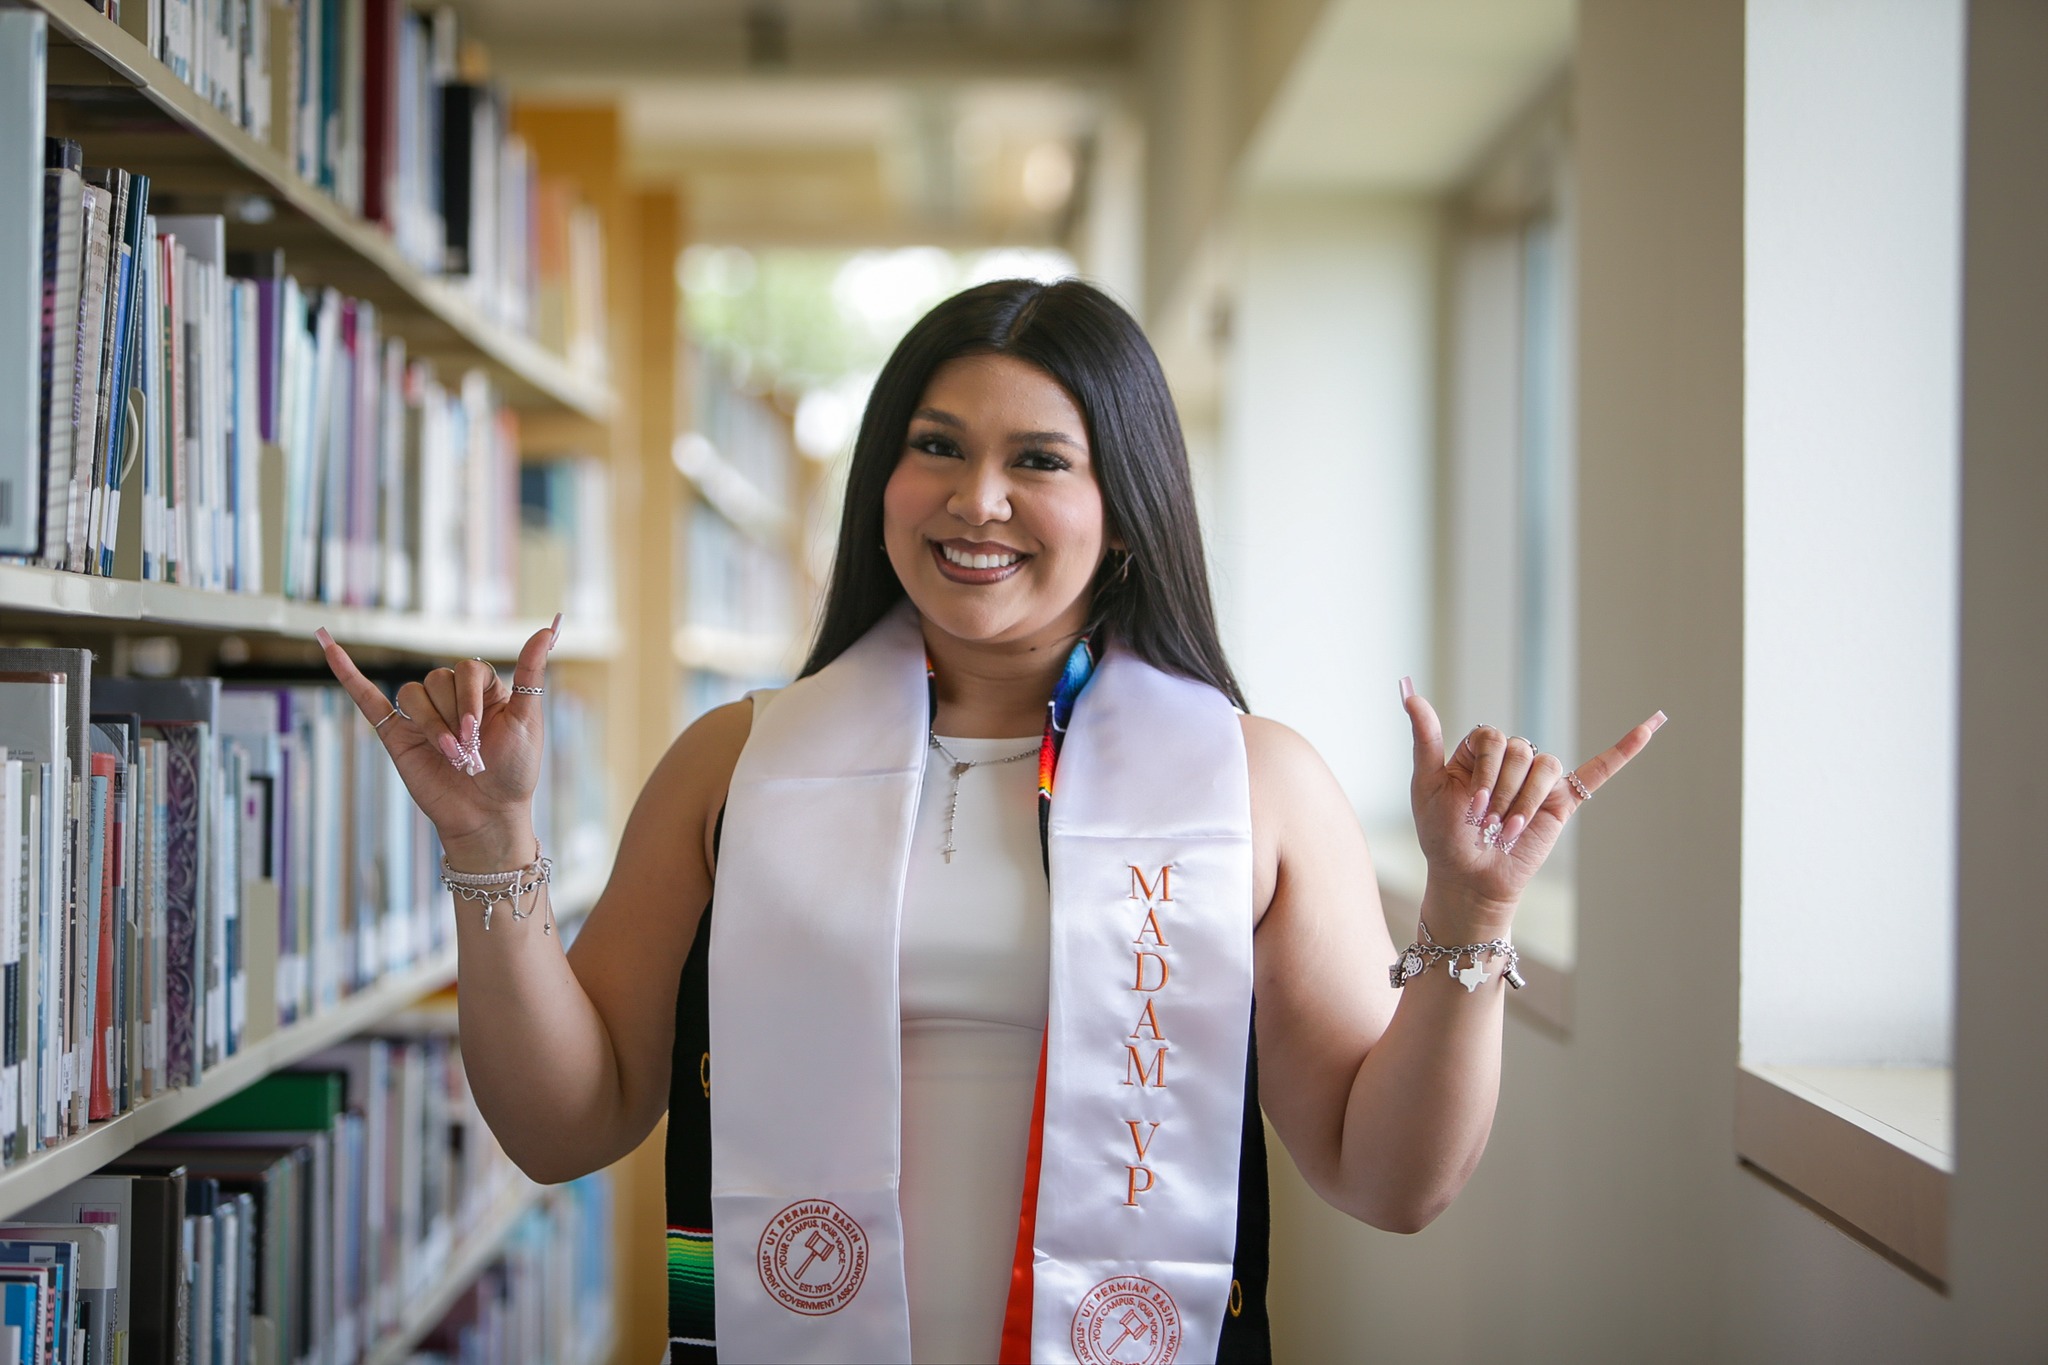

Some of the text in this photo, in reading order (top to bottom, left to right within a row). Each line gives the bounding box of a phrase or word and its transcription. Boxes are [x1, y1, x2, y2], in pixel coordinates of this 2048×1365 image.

[1123, 864, 1174, 1206] MADAM VP
[765, 1204, 861, 1246] UT PERMIAN BASIN
[779, 1242, 790, 1269] YOUR
[820, 1221, 838, 1239] YOUR
[835, 1237, 846, 1265] VOICE
[762, 1251, 864, 1310] STUDENT GOVERNMENT ASSOCIATION
[1081, 1281, 1176, 1327] UT PERMIAN BASIN
[1093, 1316, 1104, 1342] YOUR
[1137, 1300, 1154, 1320] YOUR
[1149, 1317, 1158, 1346] VOICE
[1076, 1327, 1093, 1363] STUDENT
